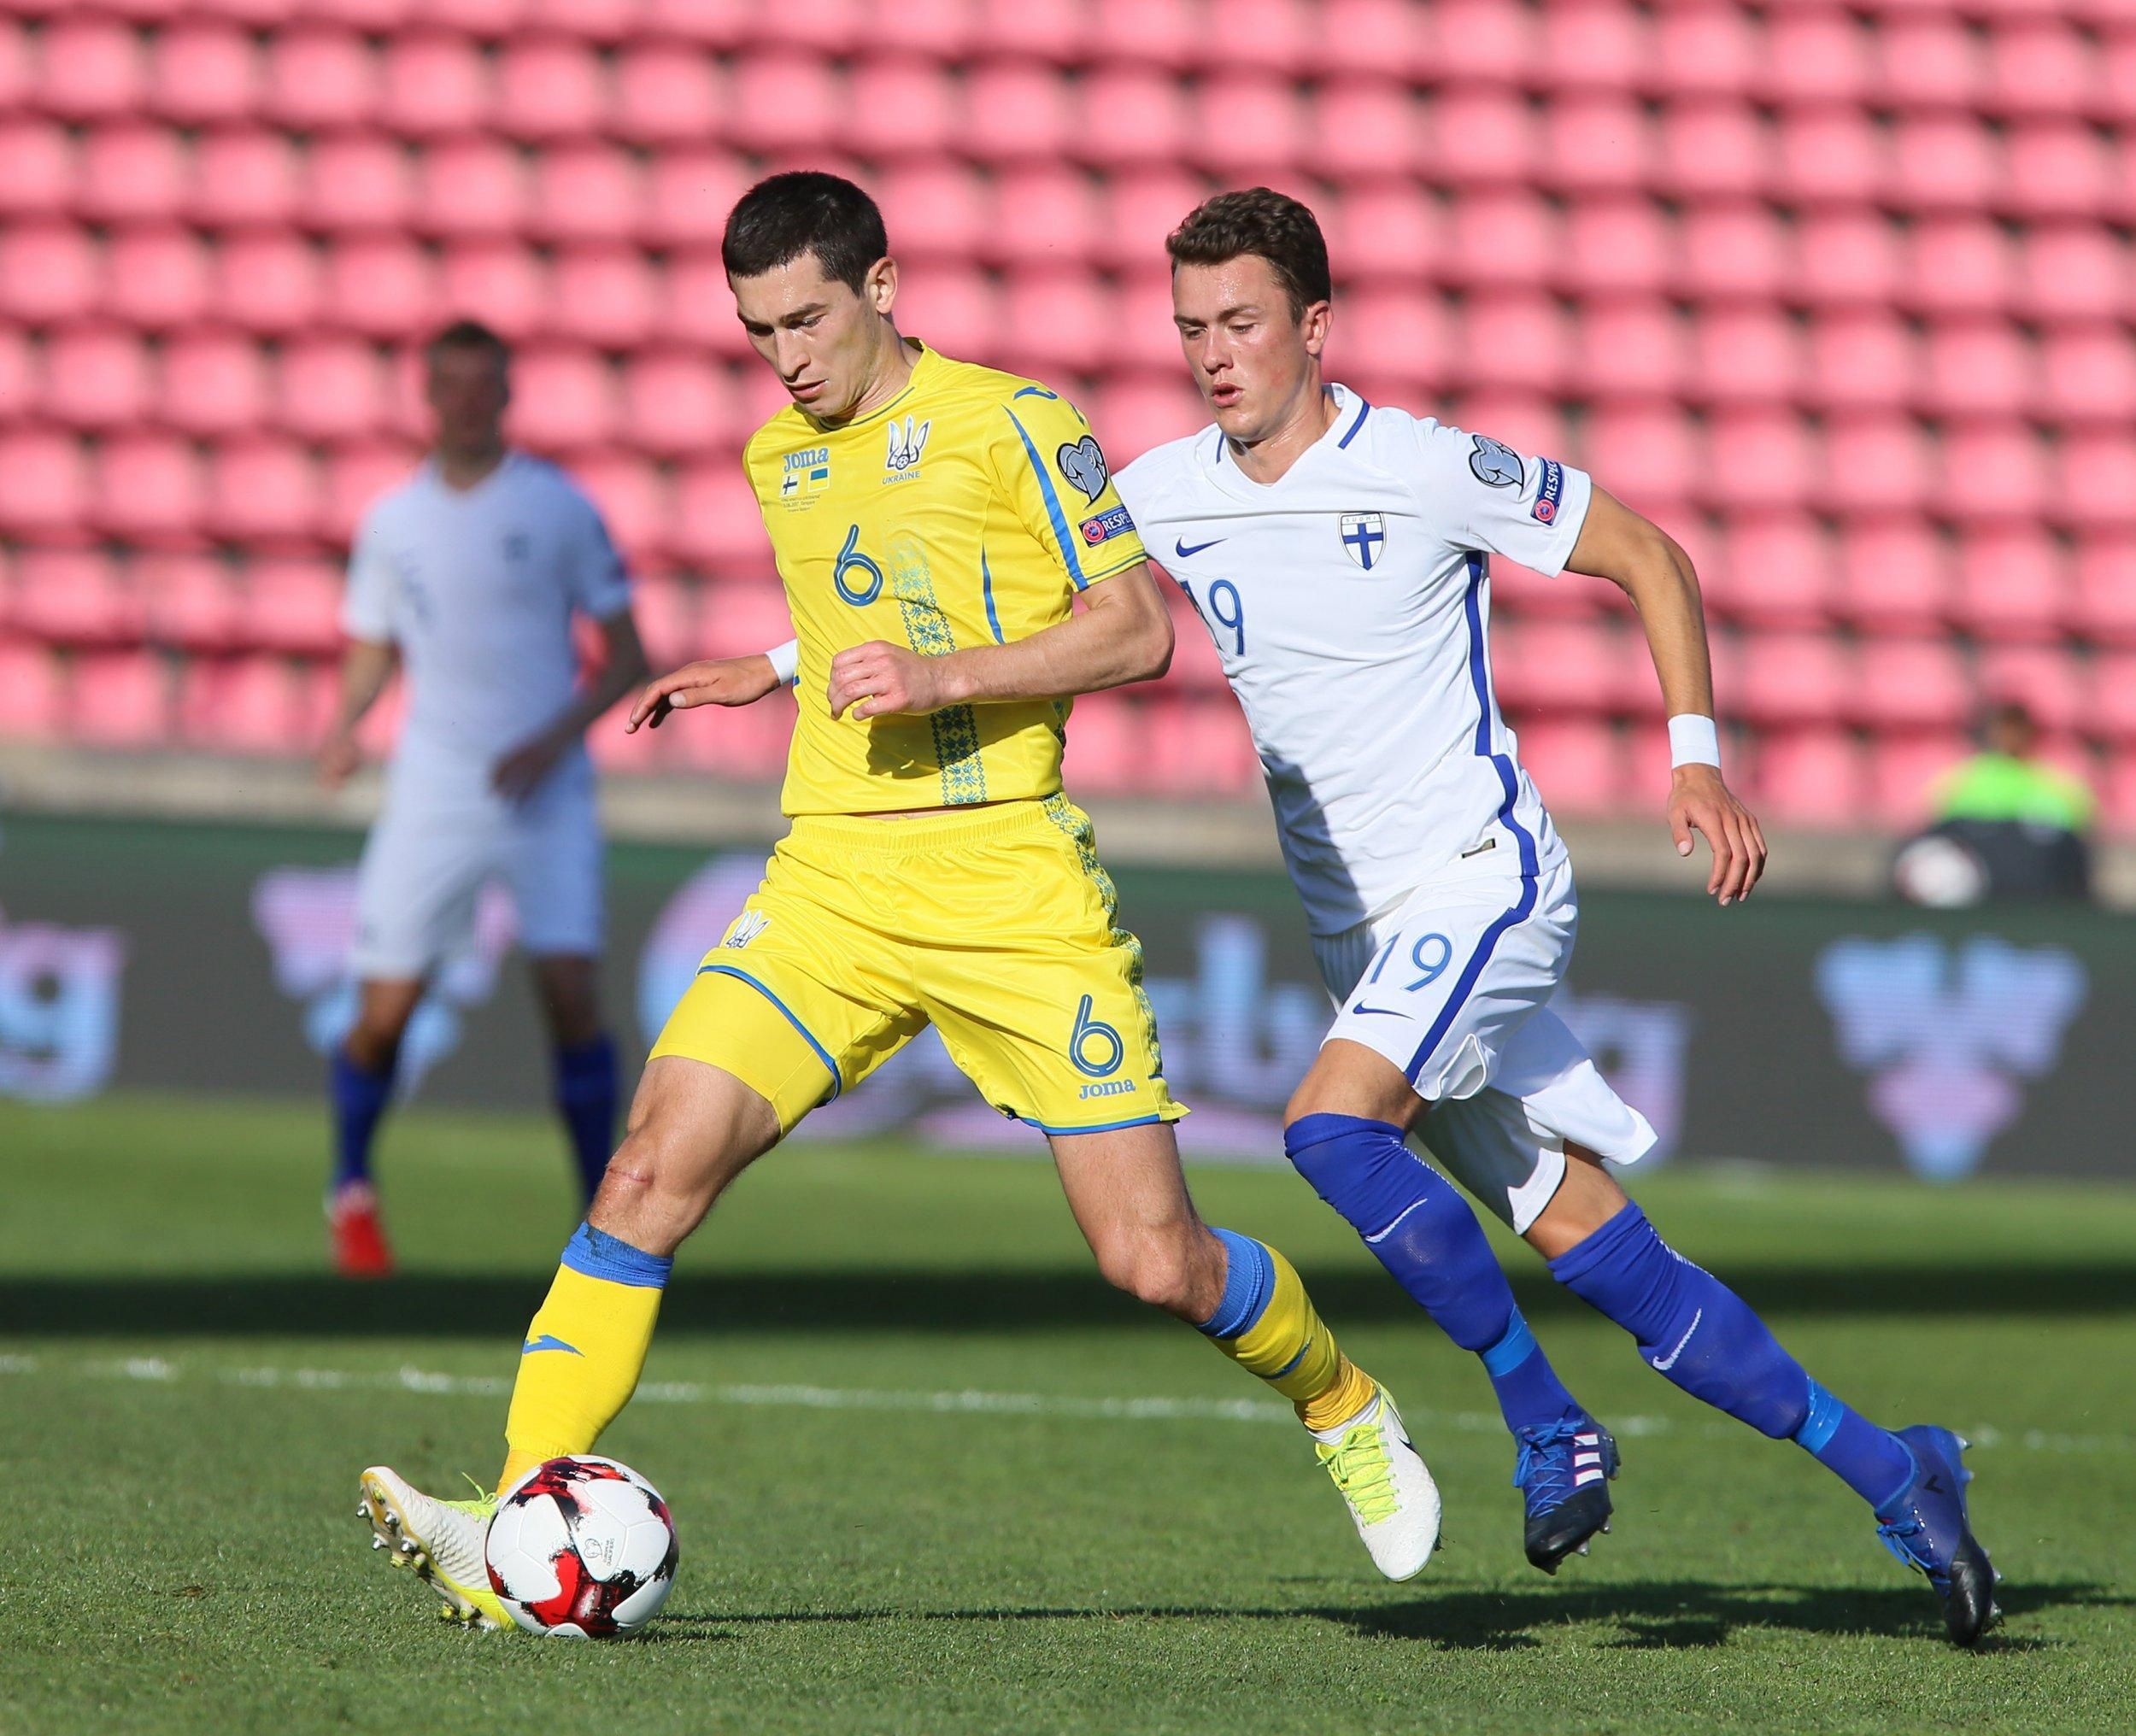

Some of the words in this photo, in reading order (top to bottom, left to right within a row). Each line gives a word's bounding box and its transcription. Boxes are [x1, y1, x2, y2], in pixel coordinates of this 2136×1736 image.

[882, 471, 921, 484] UKRAINE
[834, 524, 883, 606] 6
[1369, 931, 1452, 992] 19
[1069, 994, 1124, 1077] 6
